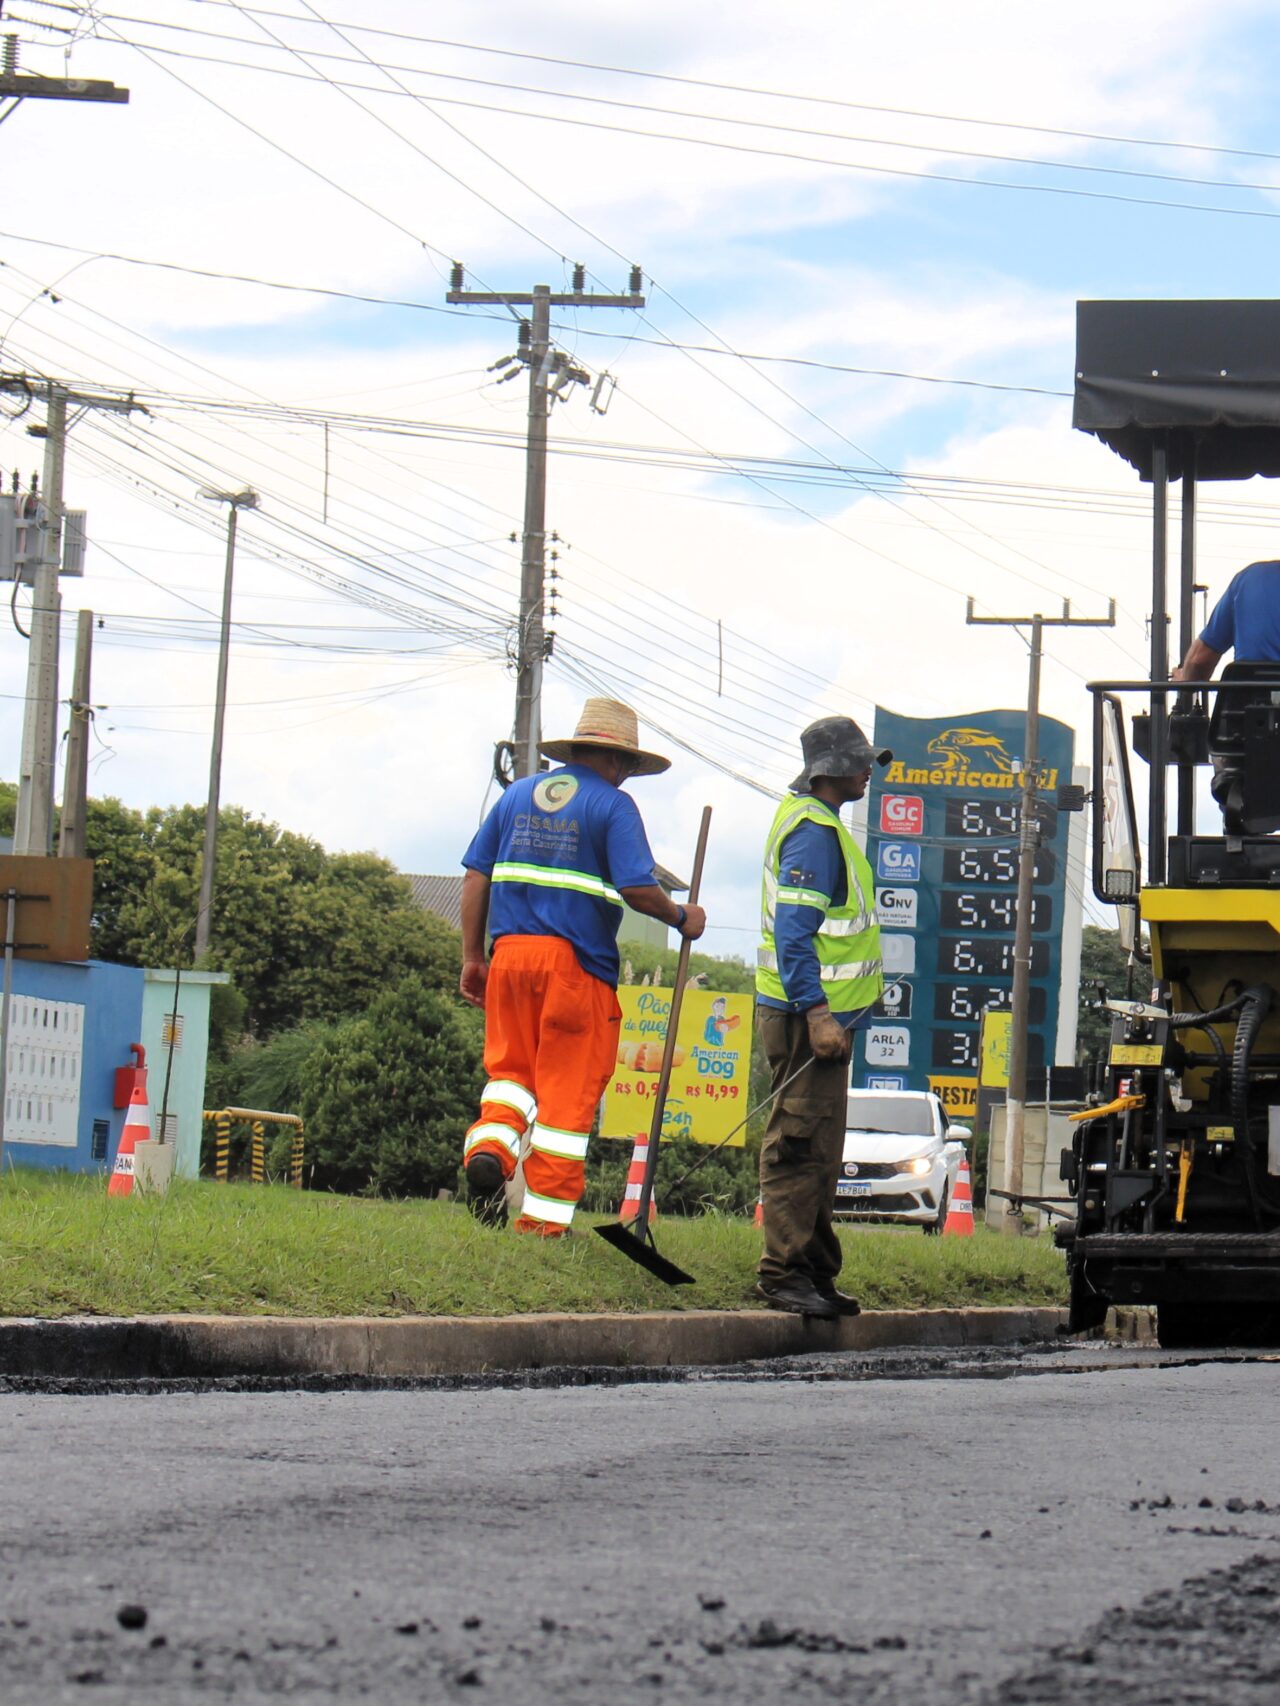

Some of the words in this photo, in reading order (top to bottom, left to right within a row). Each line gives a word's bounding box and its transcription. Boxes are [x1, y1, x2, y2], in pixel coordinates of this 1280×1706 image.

[884, 761, 1014, 789] American
[514, 814, 579, 834] CISAMA
[963, 802, 1040, 835] 6,4
[883, 845, 915, 868] GA
[960, 848, 1038, 881] 6,5
[624, 1018, 636, 1031] de
[638, 1015, 669, 1040] queij
[871, 1034, 905, 1045] ARLA
[690, 1046, 739, 1060] American
[880, 1047, 895, 1057] 32
[697, 1058, 735, 1079] Dog
[615, 1082, 632, 1095] R$
[686, 1085, 700, 1097] R$
[705, 1083, 739, 1101] 4,99
[661, 1111, 692, 1126] 24h
